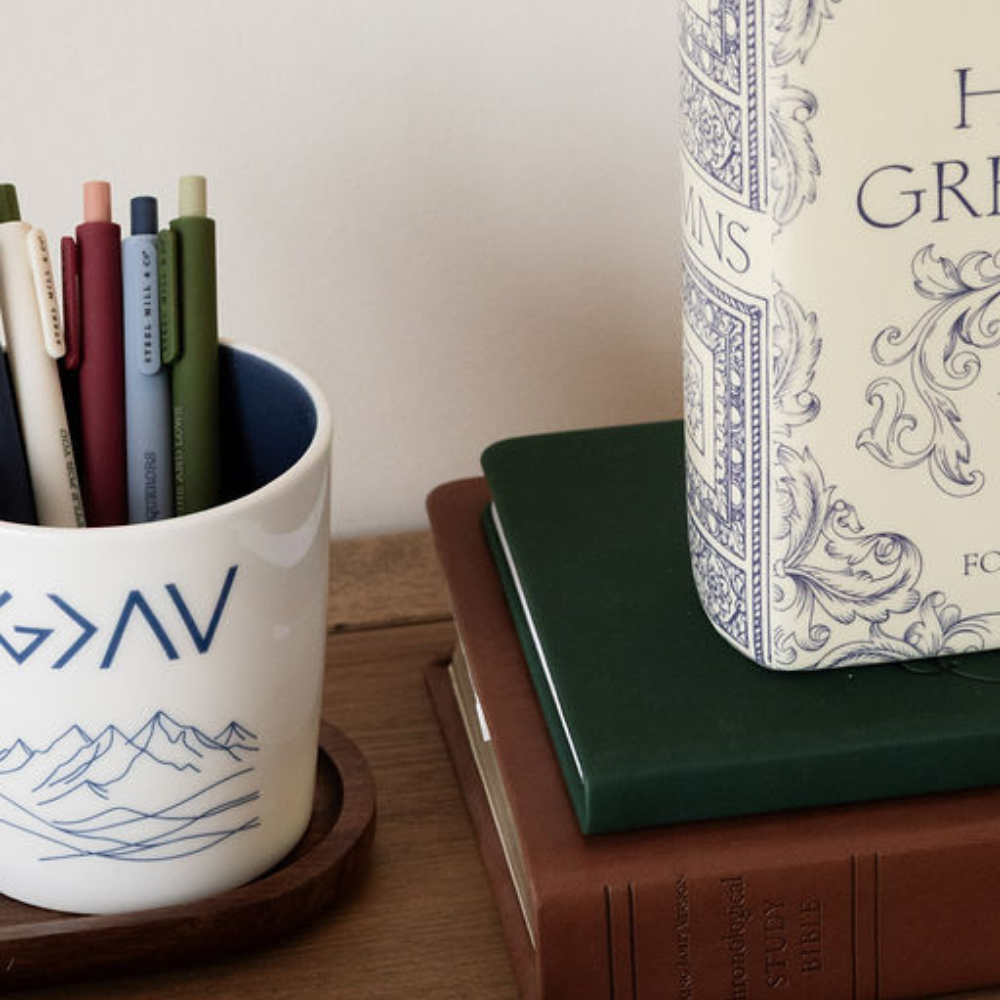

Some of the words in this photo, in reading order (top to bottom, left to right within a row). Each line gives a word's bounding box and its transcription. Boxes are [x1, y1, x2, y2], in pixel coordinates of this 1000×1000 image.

[144, 285, 152, 317] MILL
[144, 323, 152, 363] STEEL
[763, 899, 788, 988] STUDY
[800, 899, 822, 973] BIBLE
